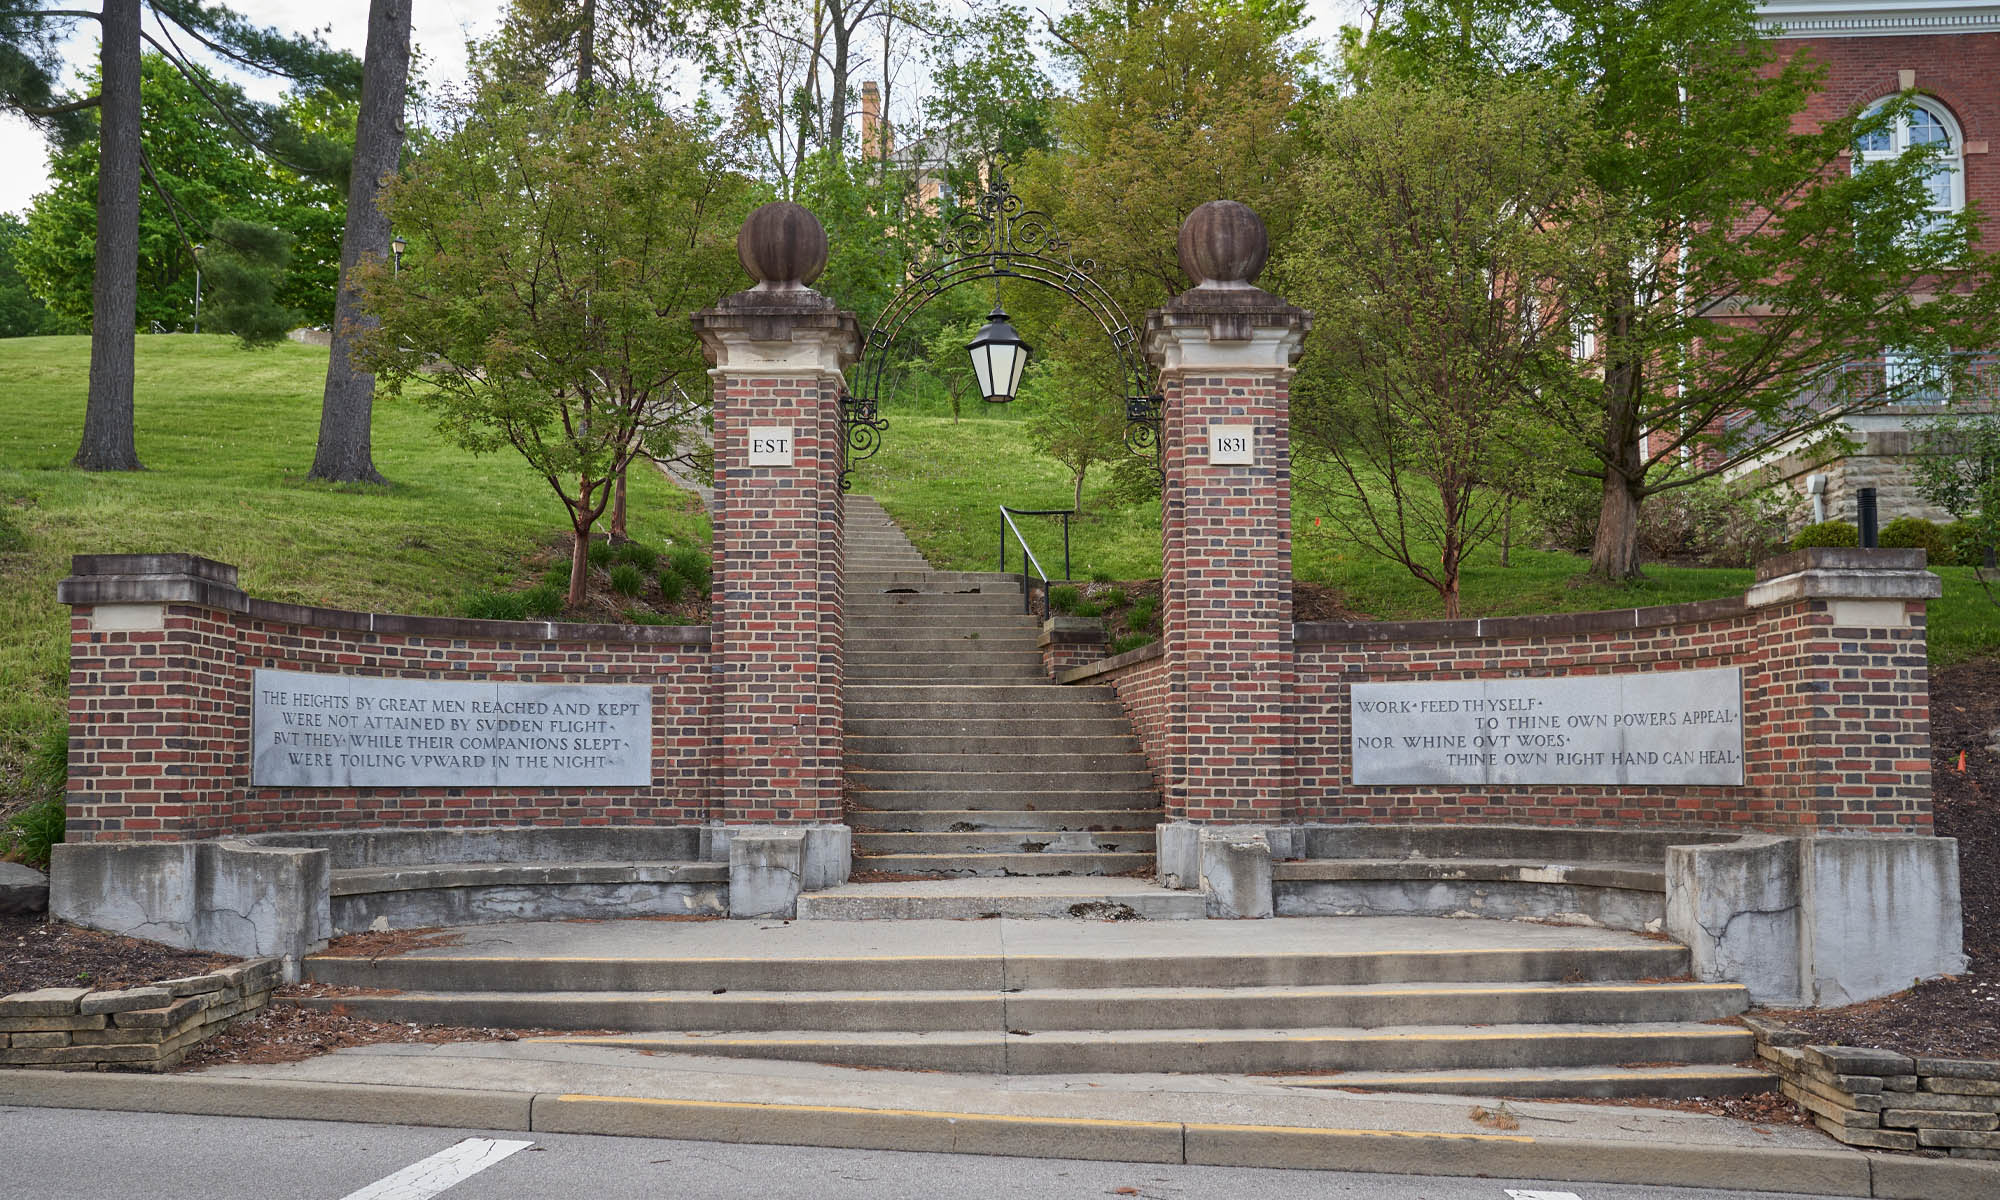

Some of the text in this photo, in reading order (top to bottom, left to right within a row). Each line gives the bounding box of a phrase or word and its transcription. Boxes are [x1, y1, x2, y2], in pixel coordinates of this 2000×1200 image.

[753, 439, 788, 453] EST.
[1217, 437, 1246, 452] 1831
[262, 691, 640, 716] THE HEIGHTS BY GREAT MEN REACHED AND KEPT
[1420, 700, 1459, 712] FEED
[282, 712, 321, 727] WERE
[328, 715, 359, 729] NOT
[364, 716, 445, 730] ATTAINED
[451, 719, 473, 731] BY
[1474, 717, 1498, 730] TO
[1506, 716, 1561, 729] THINE
[1567, 714, 1607, 728] OWN
[1613, 712, 1677, 727] POWERS
[350, 735, 403, 747] WHILE
[406, 736, 454, 749] THEIR
[460, 737, 568, 750] COMPANIONS
[1358, 737, 1395, 749] NOR
[1403, 736, 1467, 749] WHINE
[289, 753, 334, 766] WERE
[340, 754, 406, 767] TOILING
[492, 756, 509, 768] IN
[516, 756, 549, 768] THE
[1446, 753, 1497, 766] THINE
[1504, 753, 1547, 765] OWN
[1556, 752, 1605, 765] RIGHT
[1612, 752, 1659, 765] HAND
[1663, 751, 1694, 765] CAN
